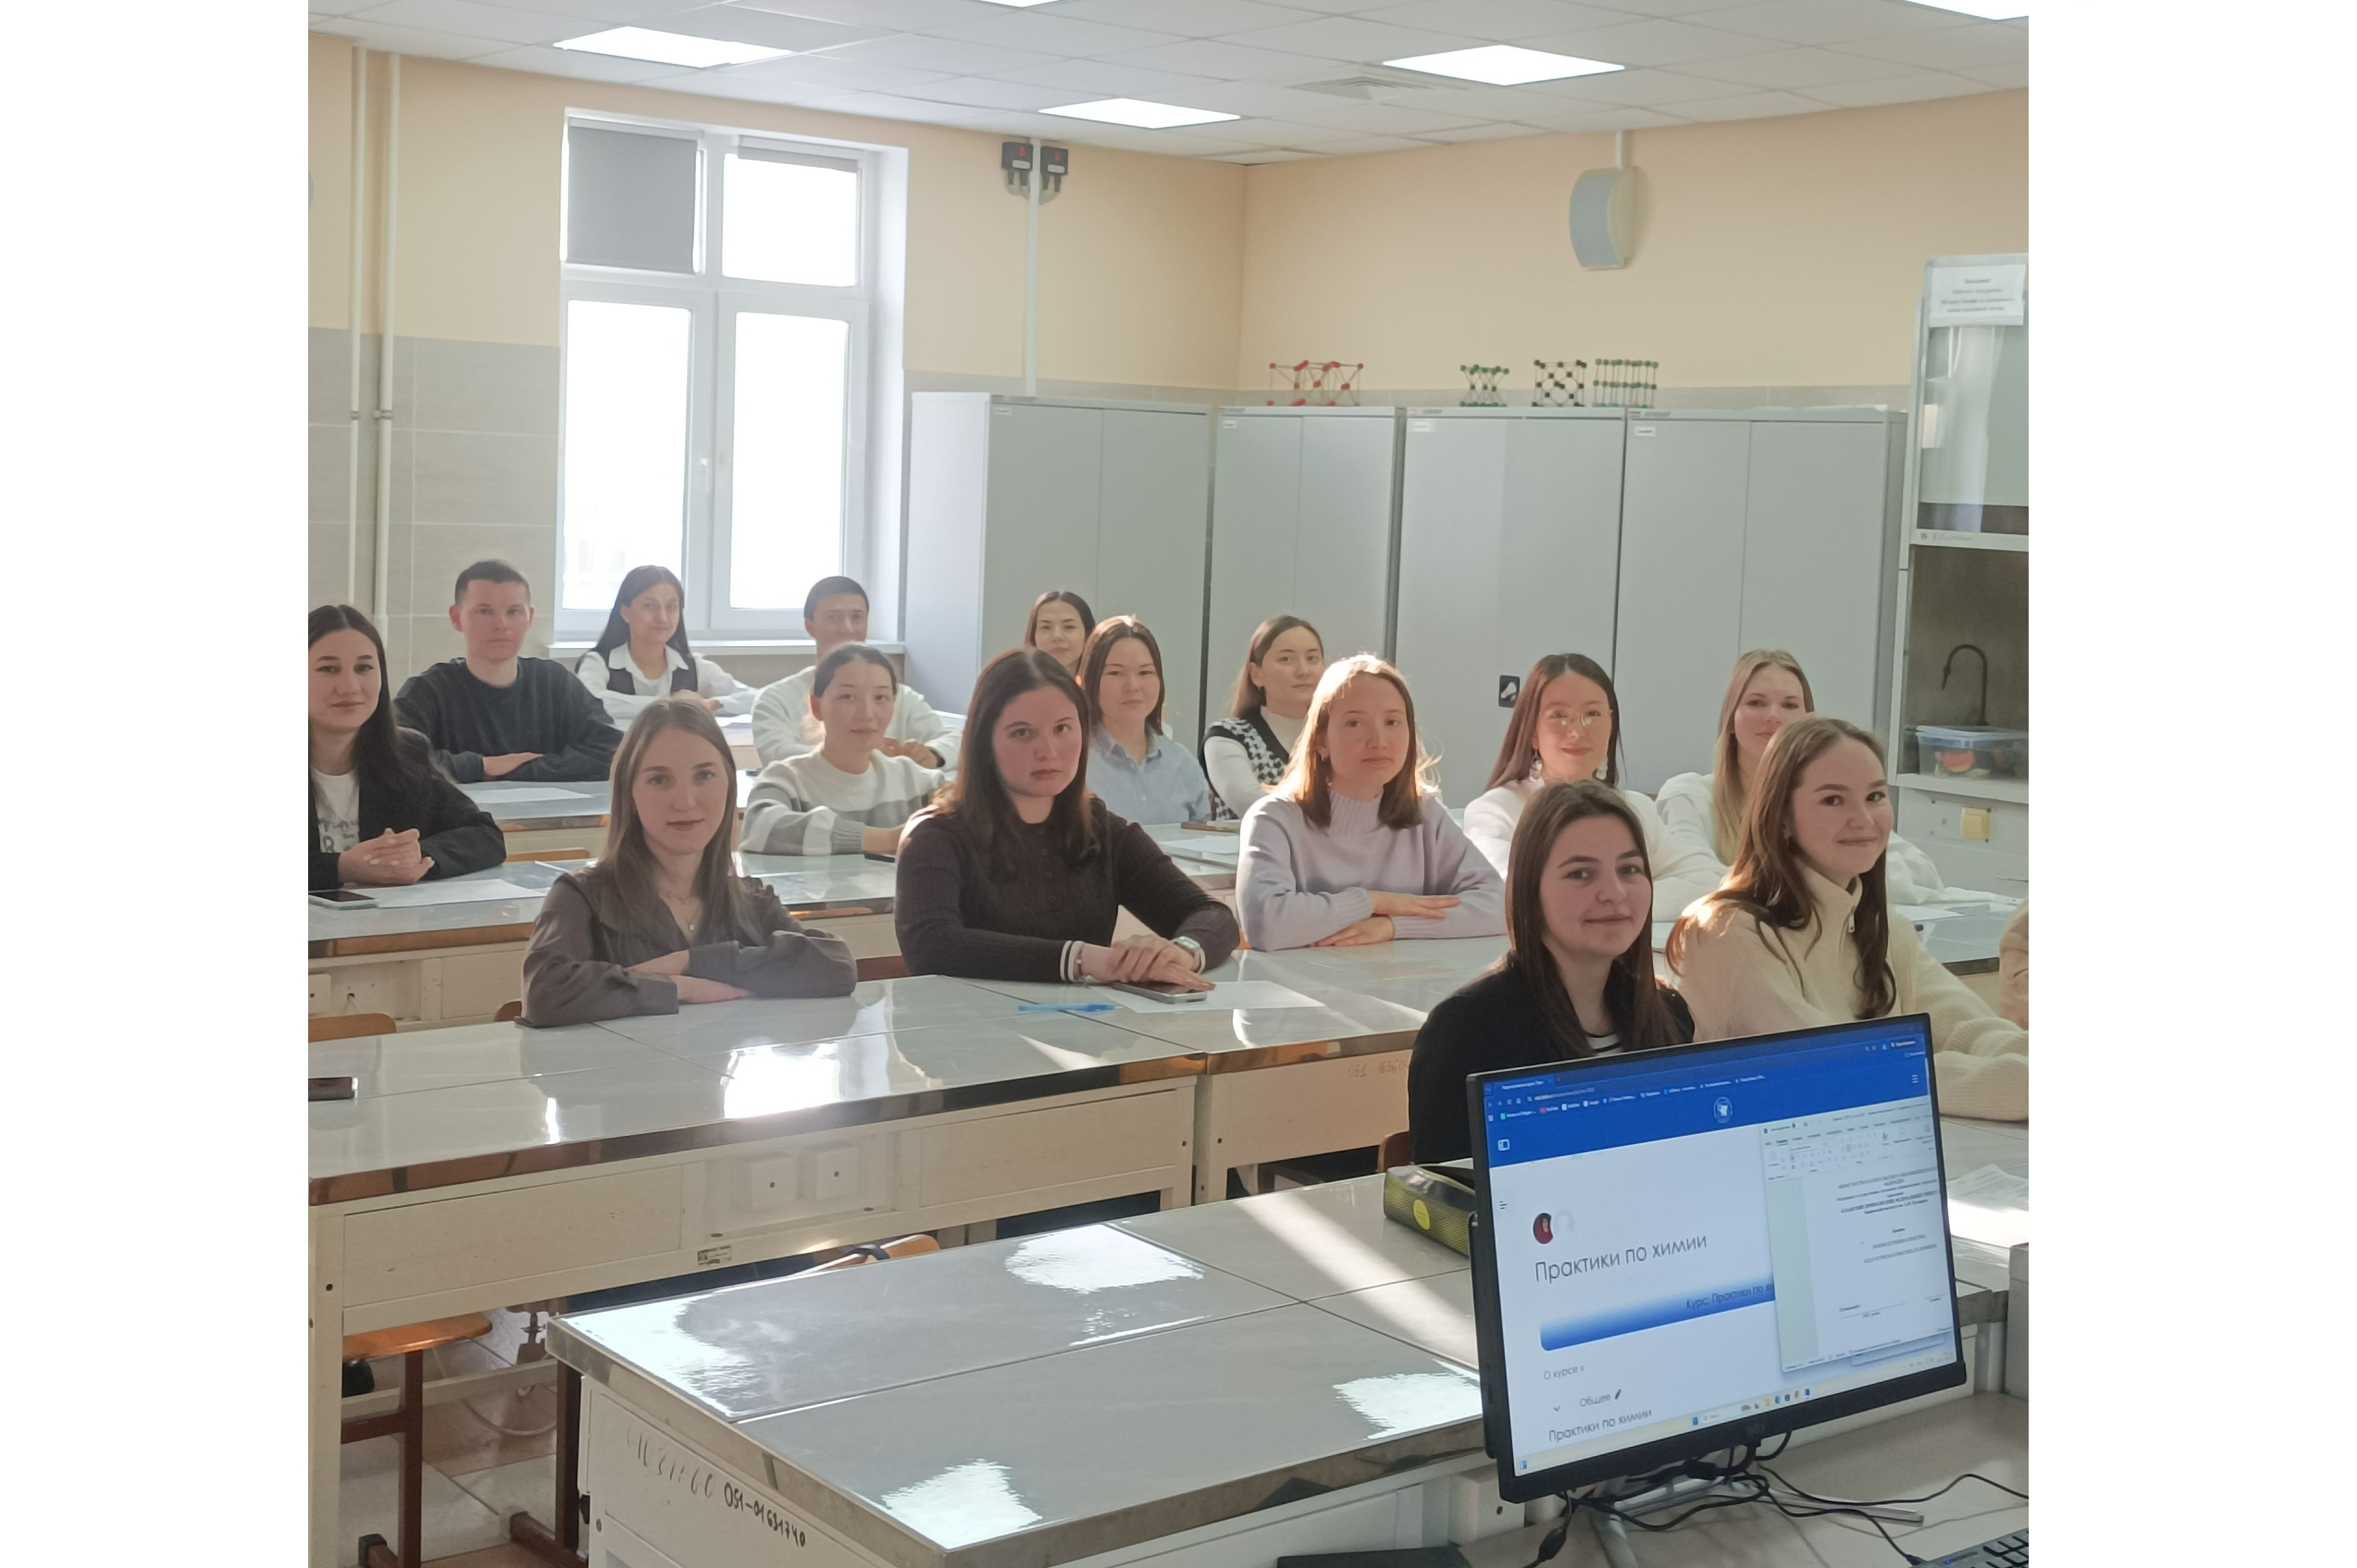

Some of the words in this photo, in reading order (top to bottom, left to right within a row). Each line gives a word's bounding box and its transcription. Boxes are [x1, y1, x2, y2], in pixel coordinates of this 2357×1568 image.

[1535, 1253, 1620, 1284] Практики
[1625, 1246, 1647, 1264] по
[1652, 1235, 1707, 1259] химии
[1712, 1288, 1751, 1305] Практики
[1752, 1285, 1764, 1294] по
[1553, 1365, 1578, 1378] курсе
[1579, 1393, 1611, 1408] Общее
[1548, 1422, 1599, 1442] Практики
[1602, 1418, 1615, 1428] по
[1618, 1409, 1653, 1424] химии
